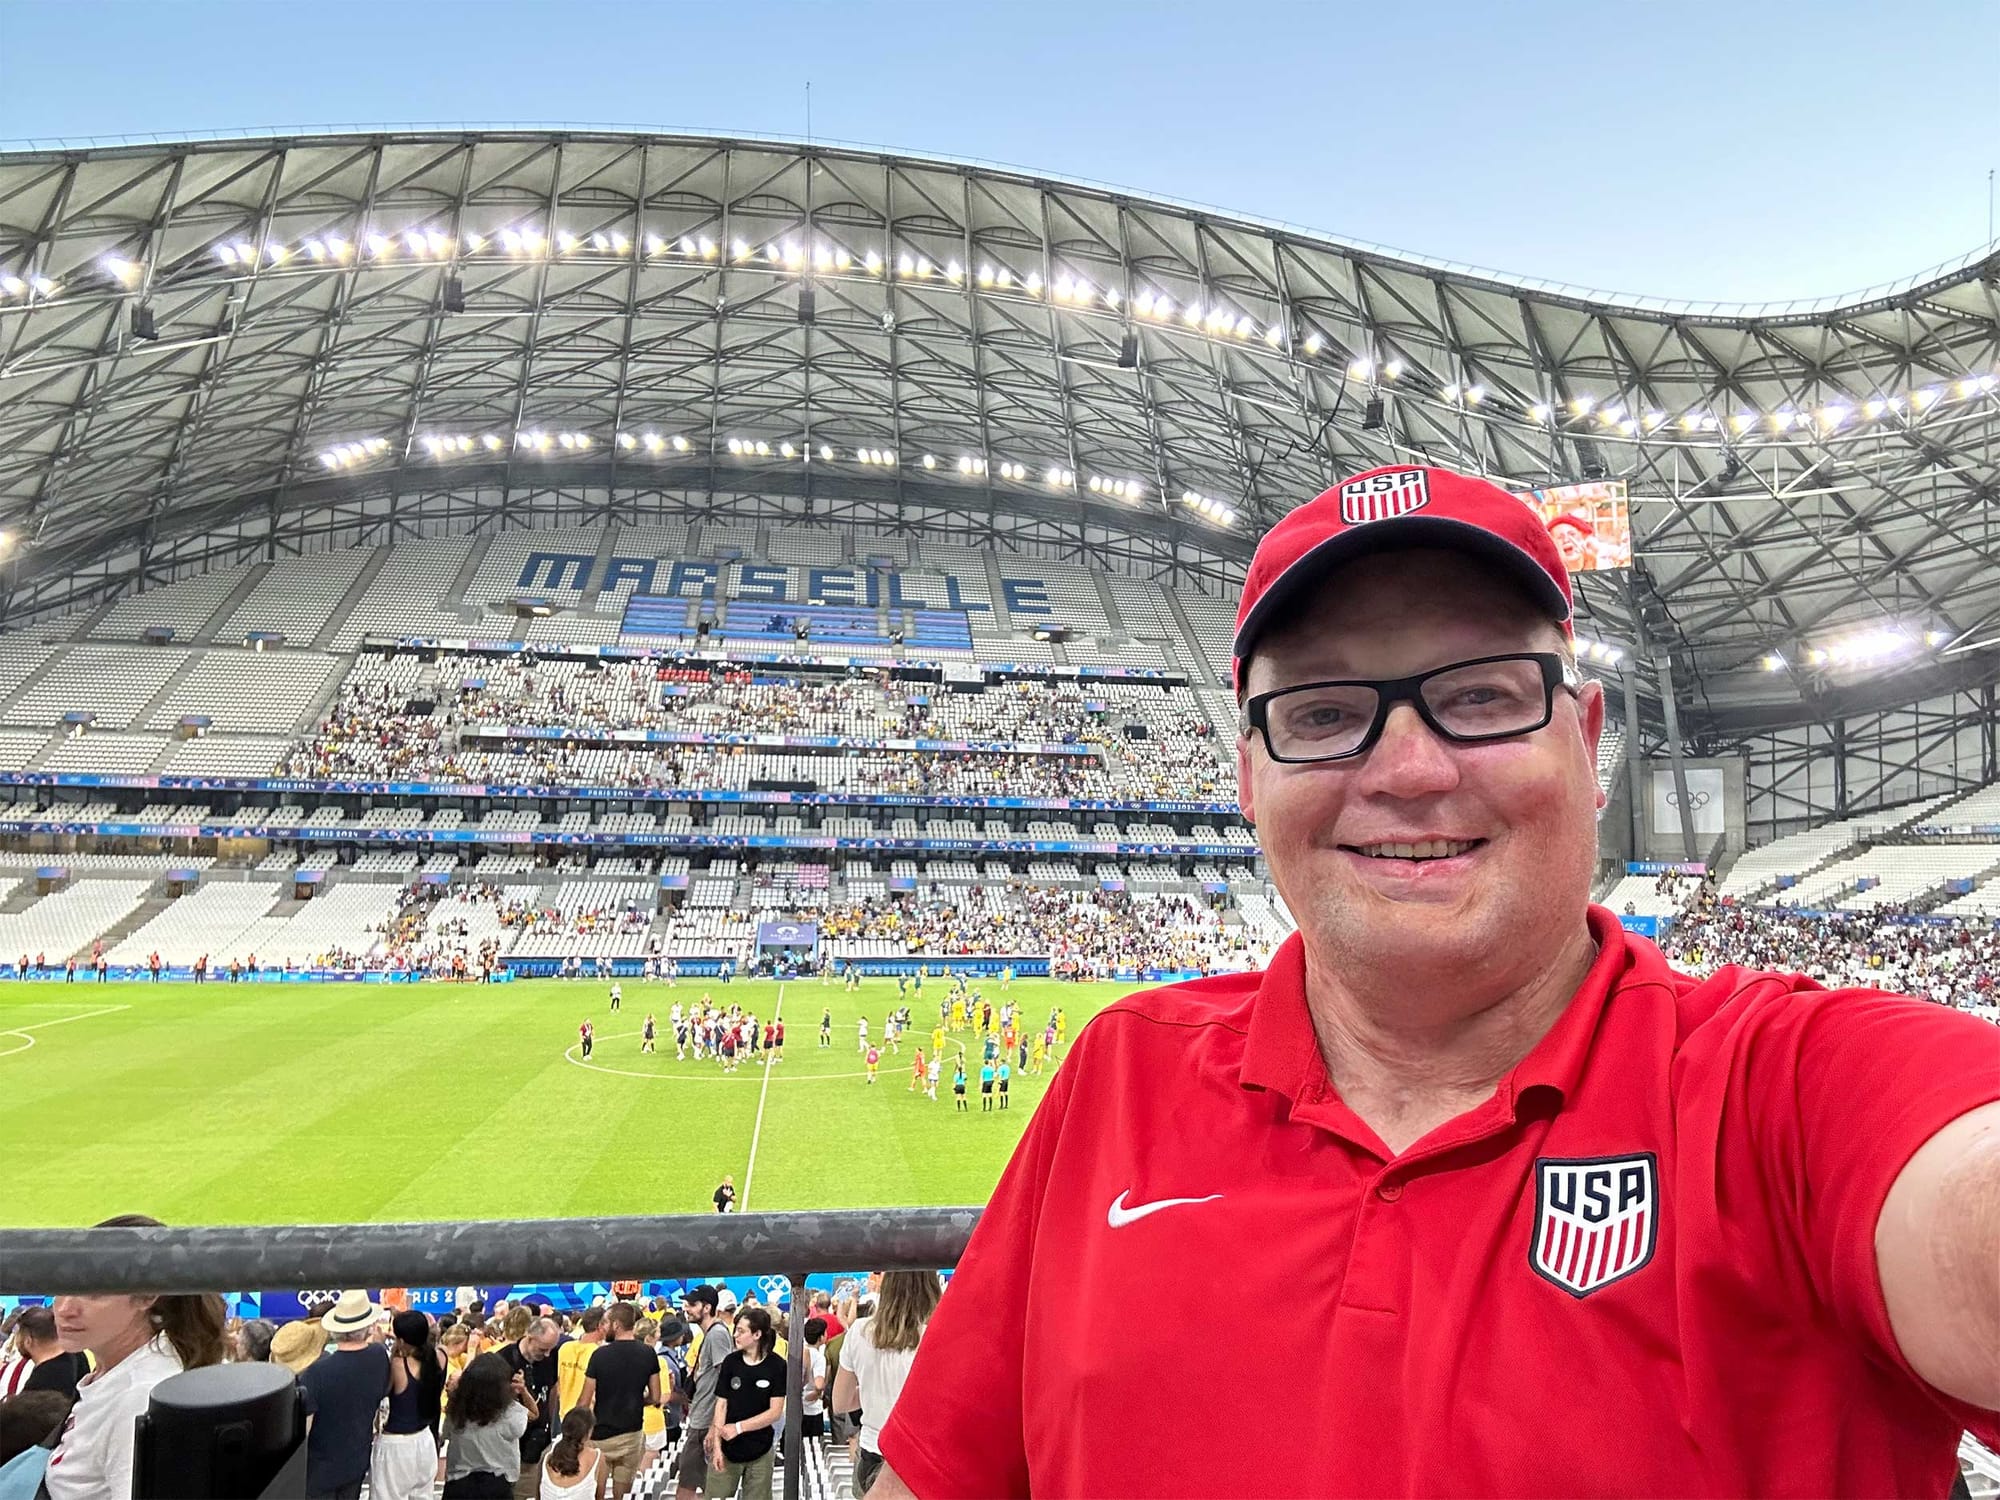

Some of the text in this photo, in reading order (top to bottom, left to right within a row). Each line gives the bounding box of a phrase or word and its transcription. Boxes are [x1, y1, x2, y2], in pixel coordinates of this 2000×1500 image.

[1348, 472, 1419, 494] USA
[516, 552, 1052, 614] MARSEILLE
[1550, 1166, 1645, 1223] USA
[412, 1289, 488, 1304] RIS 24
